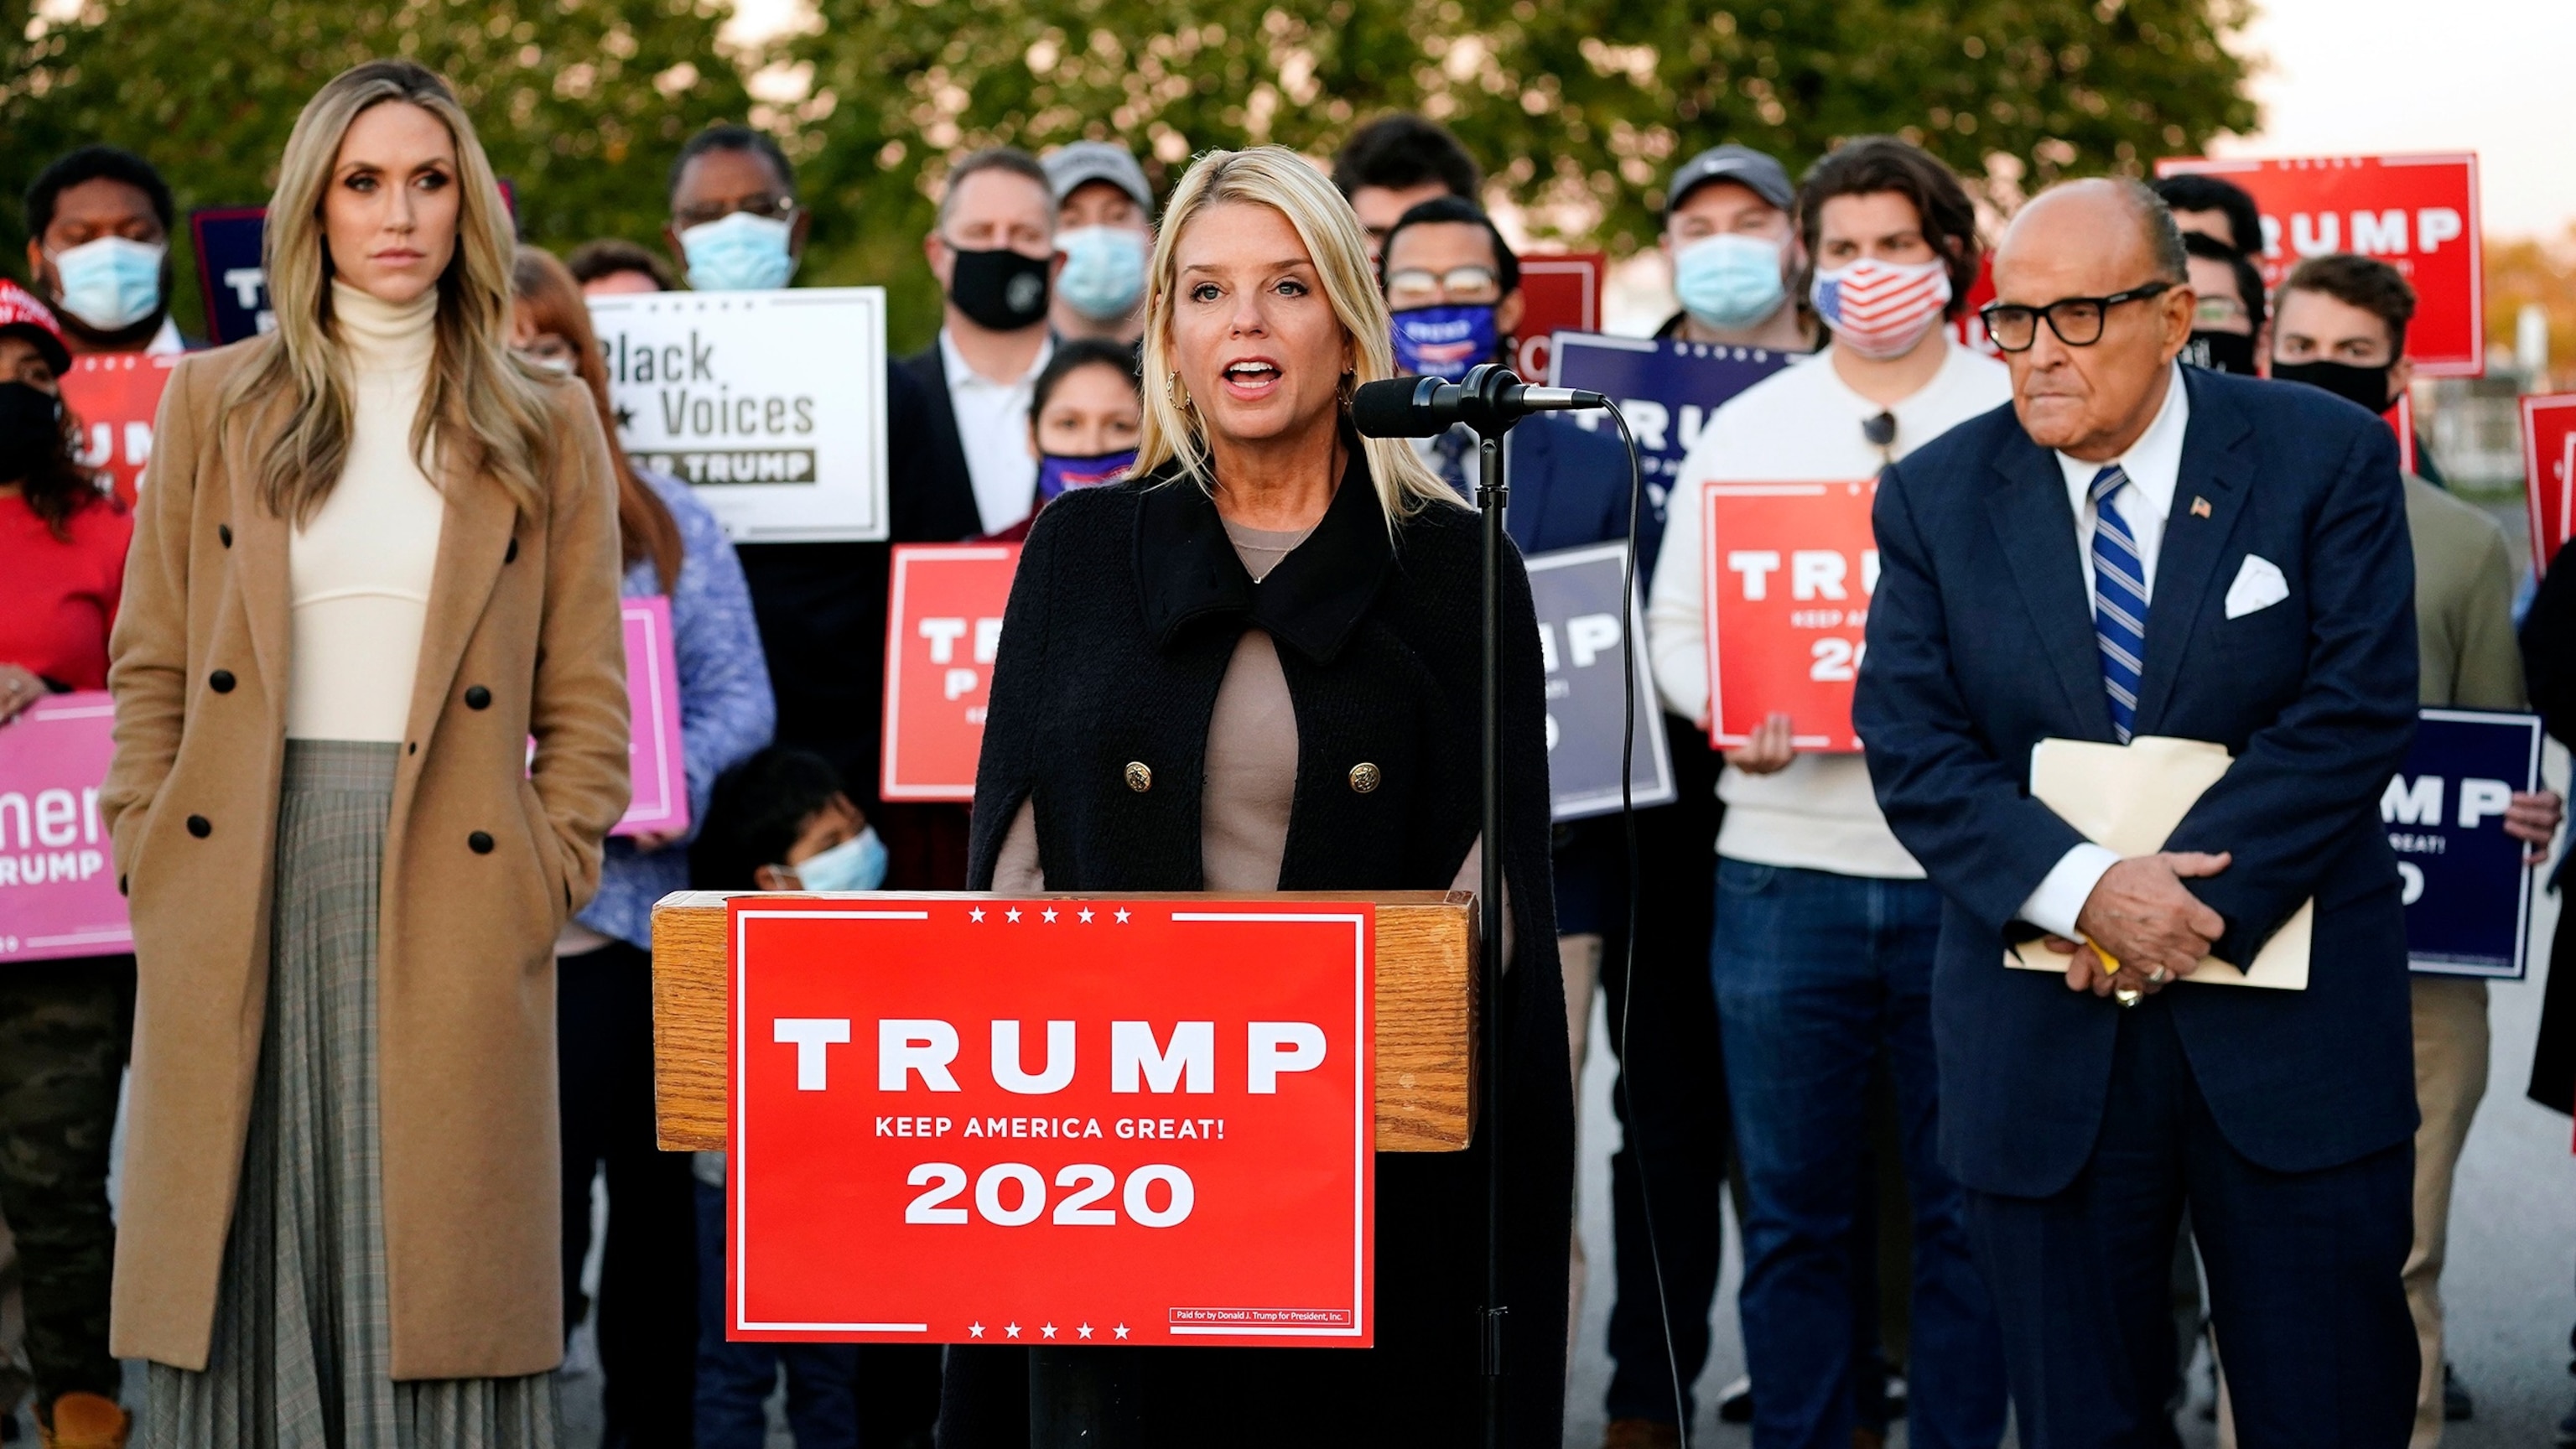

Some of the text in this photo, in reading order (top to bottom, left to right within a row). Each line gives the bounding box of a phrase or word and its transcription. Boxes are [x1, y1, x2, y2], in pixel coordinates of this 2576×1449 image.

[662, 384, 813, 435] Voices
[683, 452, 811, 482] TRUMP
[773, 1018, 1327, 1094] TRUMP
[875, 1116, 1224, 1140] KEEP AMERICA GREAT!
[905, 1162, 1195, 1228] 2020
[1176, 1311, 1192, 1319] Paid
[1194, 1311, 1206, 1319] for
[1207, 1311, 1217, 1320] by
[1253, 1311, 1277, 1321] Trump
[1278, 1311, 1290, 1320] for
[1291, 1312, 1328, 1321] President,
[1330, 1312, 1343, 1321] Inc.
